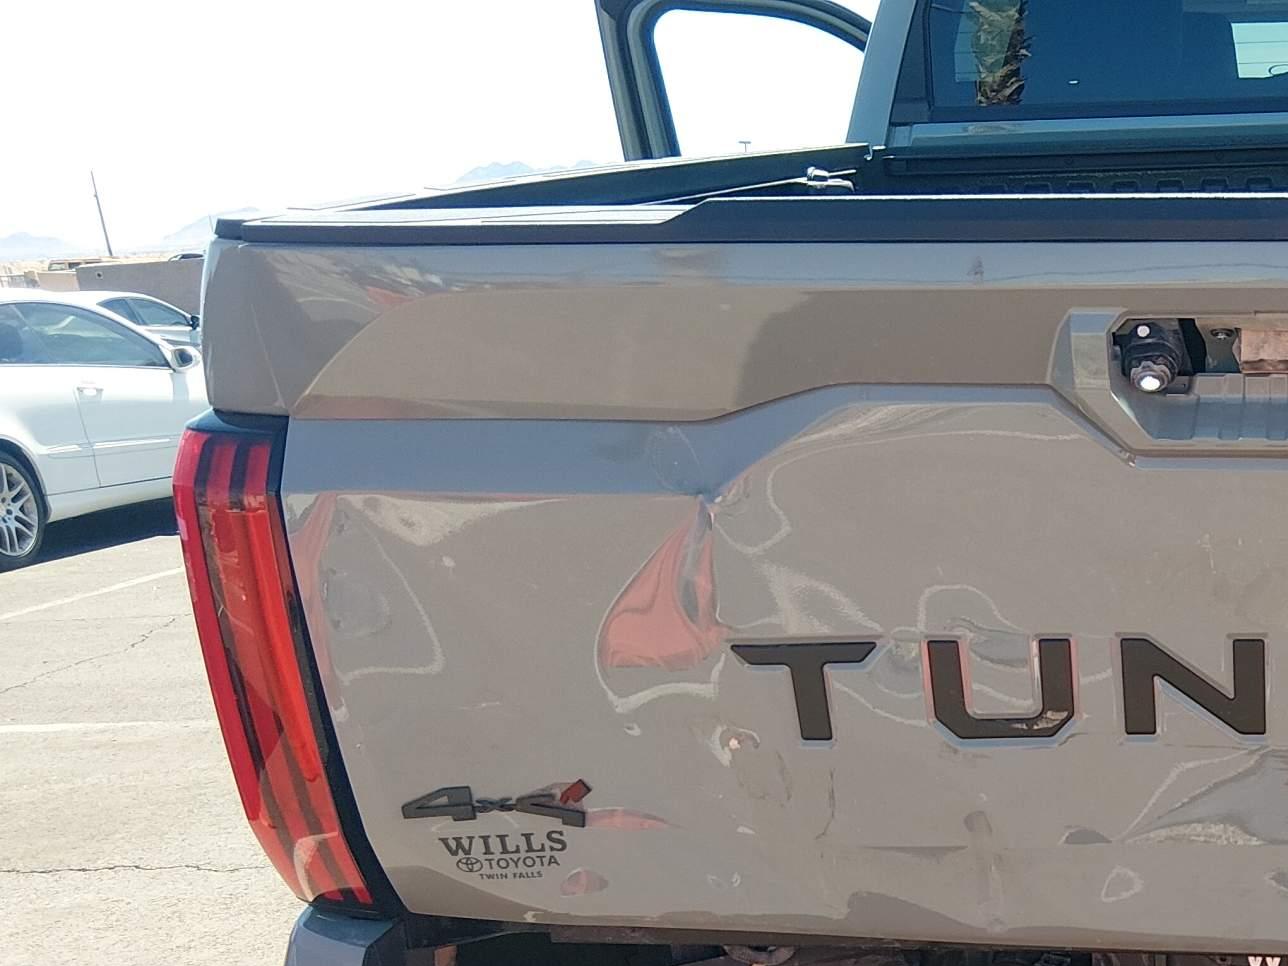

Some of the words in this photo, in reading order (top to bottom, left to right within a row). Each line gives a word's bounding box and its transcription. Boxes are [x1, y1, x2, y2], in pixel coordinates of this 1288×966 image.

[438, 830, 568, 857] WILLS
[484, 855, 561, 870] TOYOTA
[479, 872, 508, 881] TWIN
[513, 870, 544, 880] FALLS
